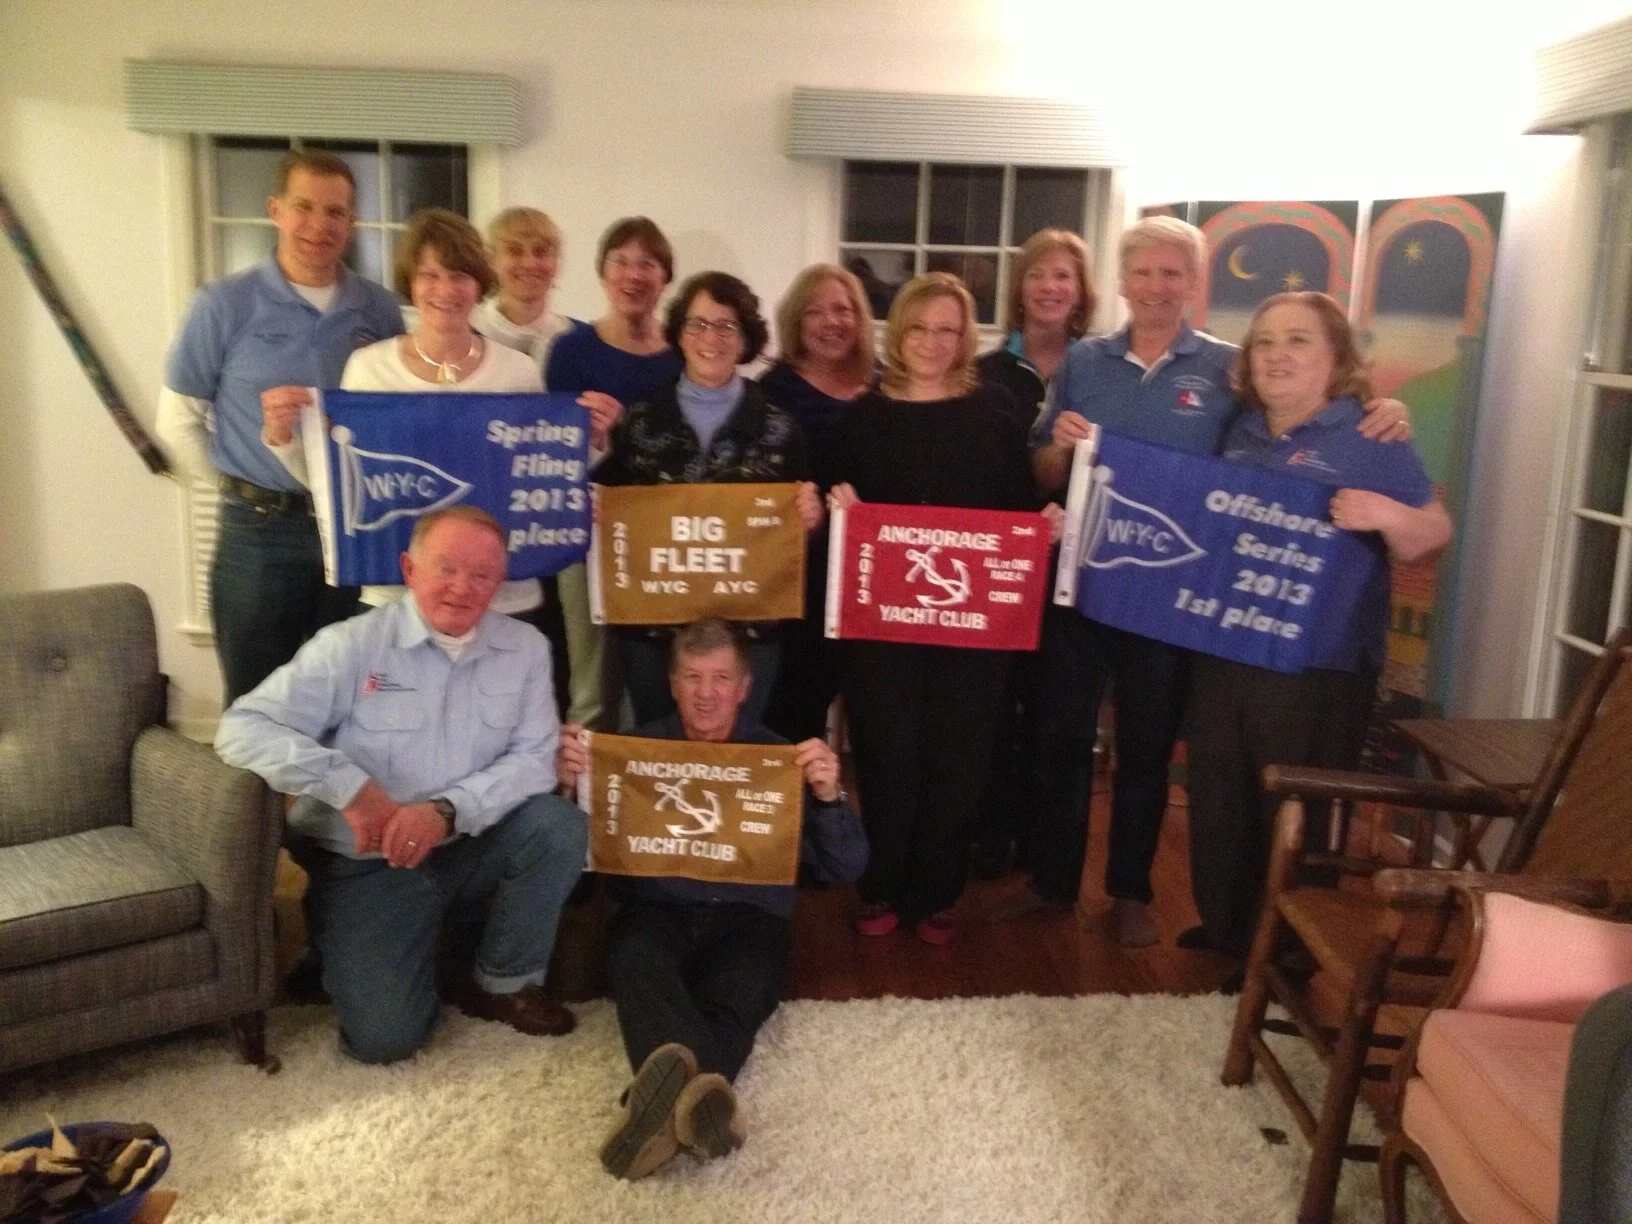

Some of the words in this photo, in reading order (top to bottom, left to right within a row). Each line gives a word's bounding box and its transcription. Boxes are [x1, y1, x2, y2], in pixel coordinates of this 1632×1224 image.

[486, 419, 584, 448] Spring
[511, 453, 585, 481] Fling
[508, 488, 587, 512] 2013
[1205, 490, 1338, 539] Offshore
[507, 522, 588, 551] place
[671, 516, 727, 542] BIG
[877, 525, 1002, 552] ANCHORAGE
[612, 521, 631, 589] 2013
[650, 547, 747, 573] FLEET
[983, 557, 999, 569] ALL
[1012, 559, 1034, 572] ONE
[1233, 532, 1325, 573] Series
[641, 580, 689, 594] WYC
[713, 580, 759, 594] AYC
[857, 543, 875, 604] 2013
[988, 591, 1023, 604] CREW
[1233, 569, 1315, 606] 2013
[879, 604, 938, 625] YACHT
[939, 610, 988, 630] CLUB
[1174, 587, 1220, 618] 1st
[1220, 605, 1302, 640] place
[625, 760, 752, 782] ANCHORAGE
[606, 774, 622, 836] 2013
[735, 788, 752, 800] ALL
[764, 790, 784, 804] ONE
[740, 821, 773, 834] CREW
[628, 835, 690, 855] YACHT
[691, 839, 738, 862] CLUB
